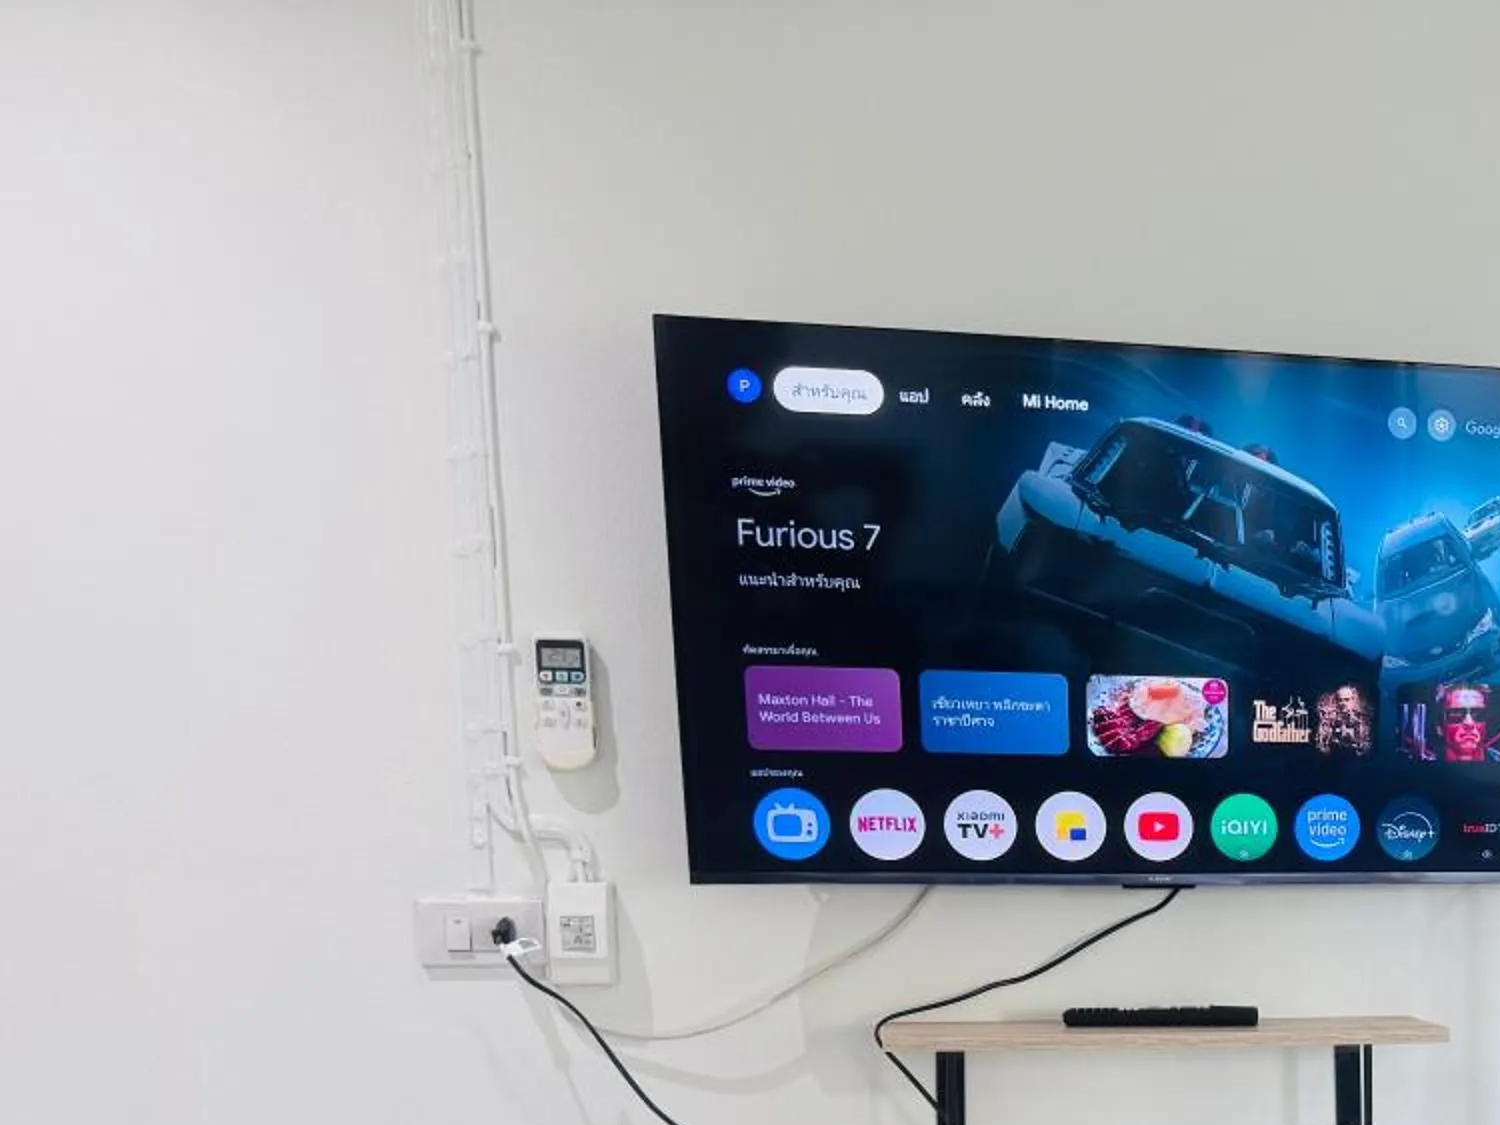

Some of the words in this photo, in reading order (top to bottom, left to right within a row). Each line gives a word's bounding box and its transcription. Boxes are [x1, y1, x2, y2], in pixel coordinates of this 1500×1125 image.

[738, 379, 750, 393] P
[791, 382, 868, 404] สำหรับคุณ
[899, 387, 930, 404] แอป
[960, 391, 992, 408] คลัง
[1022, 393, 1042, 409] Mi
[1044, 395, 1089, 411] Home
[731, 475, 764, 488] prime
[765, 477, 796, 489] video
[736, 517, 855, 550] Furious
[862, 523, 881, 551] 7
[738, 571, 862, 593] แนะนำสำหรับคุณ
[757, 693, 809, 706] Maxton
[811, 694, 836, 707] Hall
[848, 695, 874, 708] The
[759, 710, 799, 723] World
[801, 711, 860, 724] Between
[862, 711, 881, 725] Us
[1253, 699, 1277, 720] The
[1253, 720, 1311, 743] Godfather
[857, 815, 917, 833] NETFLIX
[1307, 808, 1348, 824] prime
[1220, 818, 1268, 836] iQIYI
[1308, 823, 1348, 838] video
